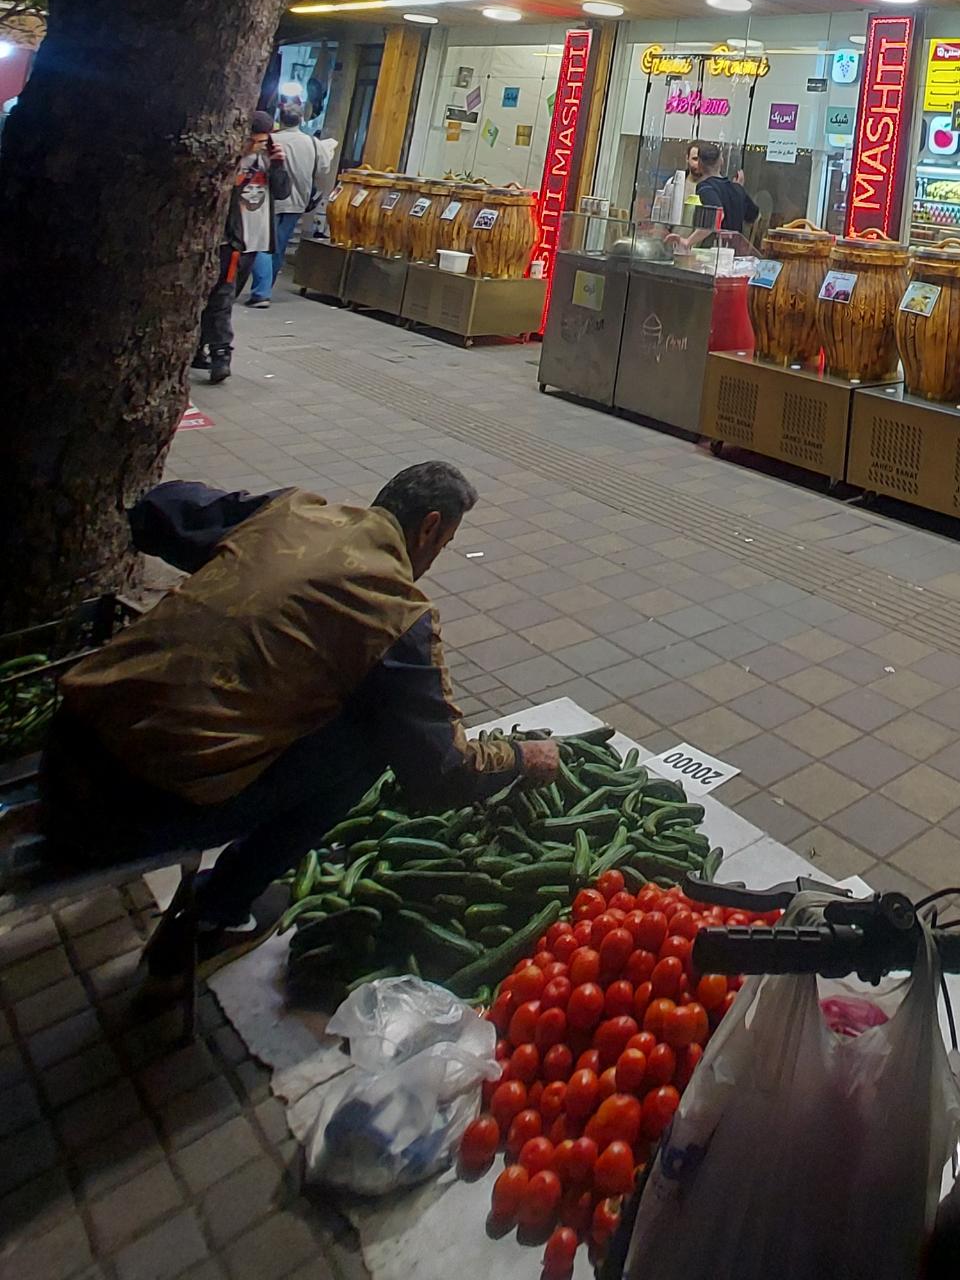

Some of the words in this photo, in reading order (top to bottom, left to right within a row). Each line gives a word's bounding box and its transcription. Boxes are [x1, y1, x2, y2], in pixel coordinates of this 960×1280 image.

[551, 47, 587, 176] MASHTI
[830, 113, 849, 126] شیک
[853, 38, 909, 210] MASHTI
[871, 460, 894, 473] JAHED
[895, 467, 918, 481] SANAT
[662, 751, 724, 786] 20000
